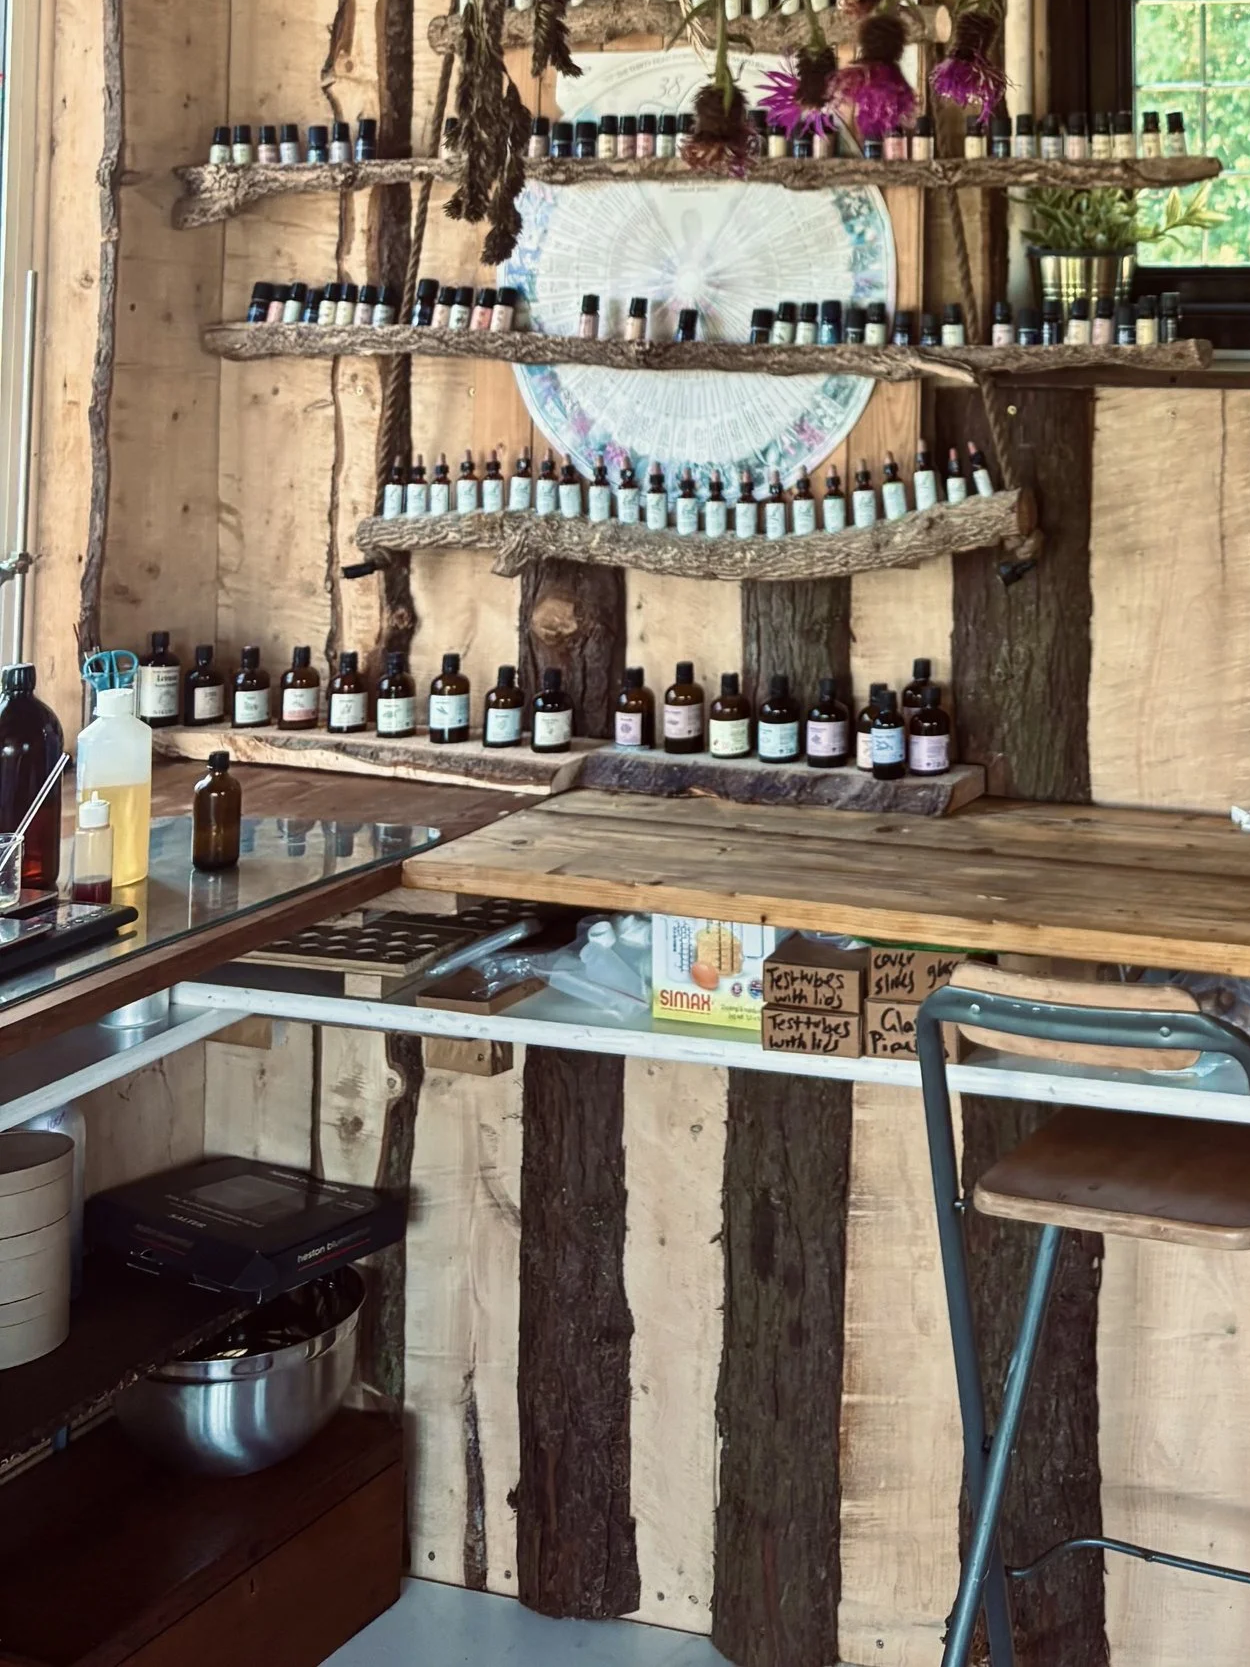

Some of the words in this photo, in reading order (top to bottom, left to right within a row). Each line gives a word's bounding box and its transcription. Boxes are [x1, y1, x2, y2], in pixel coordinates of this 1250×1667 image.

[874, 953, 915, 969] cover
[875, 969, 915, 994] slides
[660, 990, 711, 1011] SIMAX
[774, 987, 808, 1003] with
[814, 988, 842, 1009] lids
[881, 1008, 918, 1034] Gla
[769, 1032, 808, 1049] with
[811, 1031, 839, 1053] lids
[297, 1245, 326, 1263] heston
